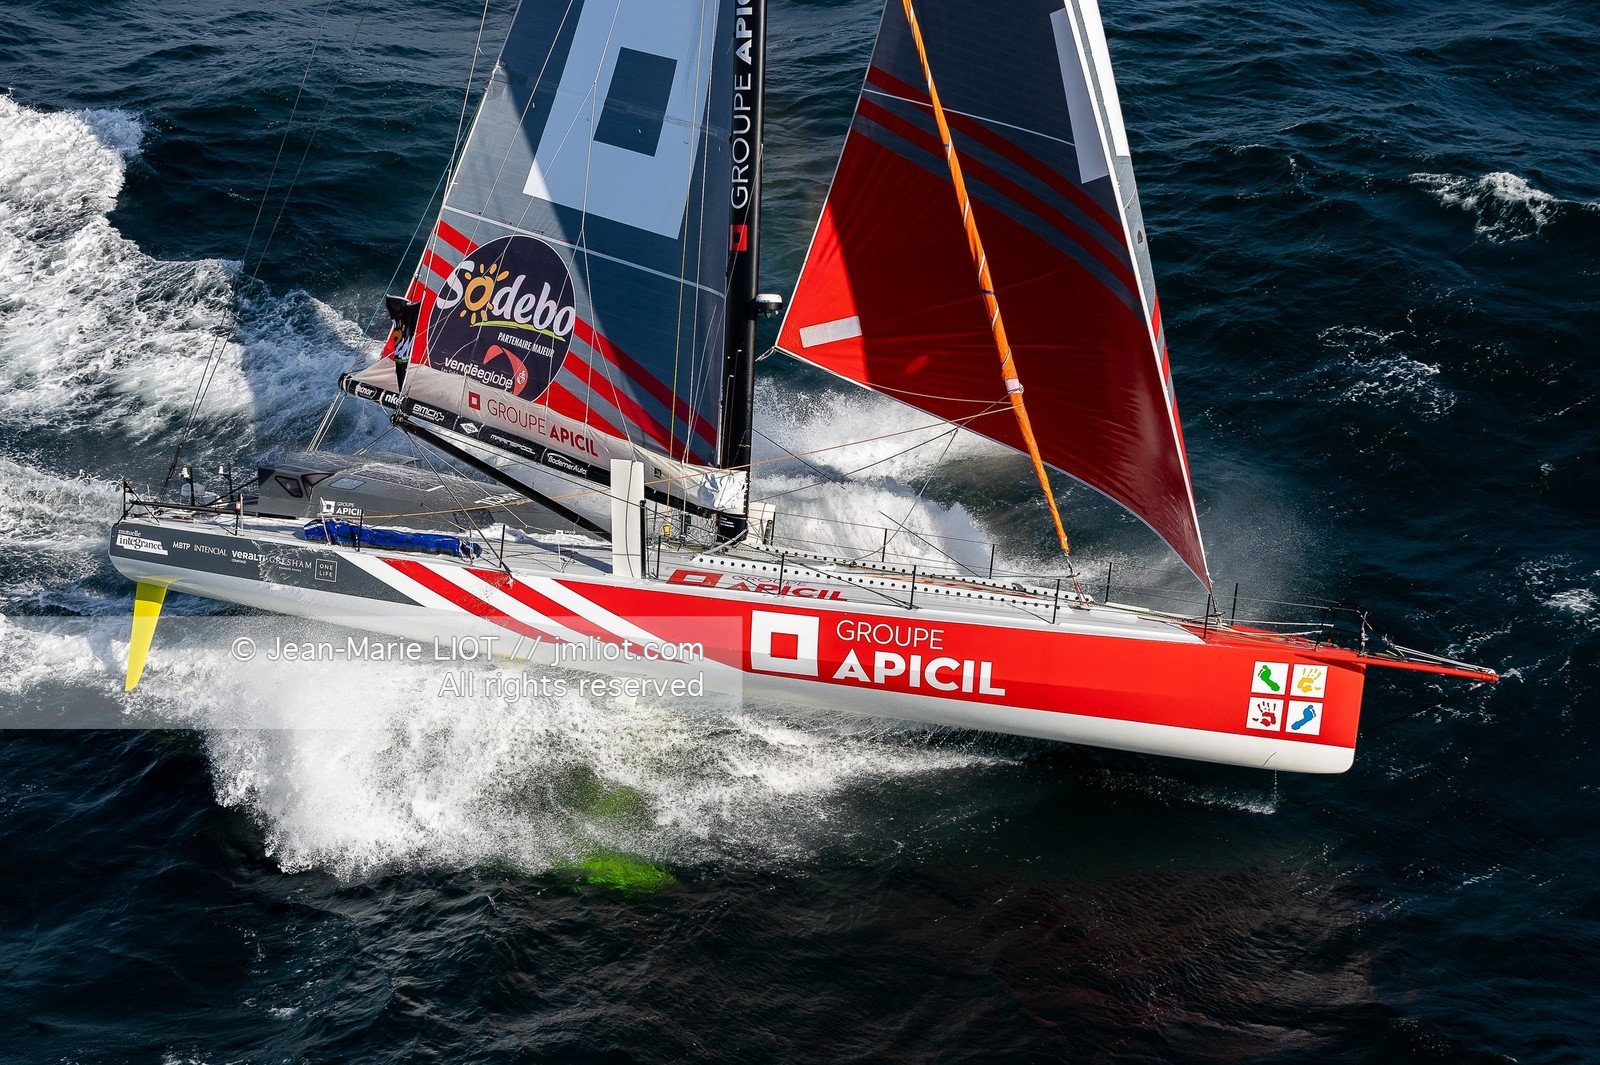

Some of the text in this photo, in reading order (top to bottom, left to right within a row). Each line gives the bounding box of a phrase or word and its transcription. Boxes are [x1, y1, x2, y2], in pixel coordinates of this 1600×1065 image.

[731, 73, 751, 209] GROUPE
[436, 260, 576, 337] Sodebo
[497, 332, 555, 358] PARTENAIRE MAJEUR
[487, 398, 598, 457] GROUPE APICIL
[118, 529, 142, 537] mutuelle
[172, 541, 191, 550] MBTP
[194, 544, 227, 556] INTENCIAL
[269, 555, 312, 569] GRESHAM
[727, 582, 848, 602] APICIL
[836, 619, 945, 650] GROUPE
[832, 648, 1006, 697] APICIL
